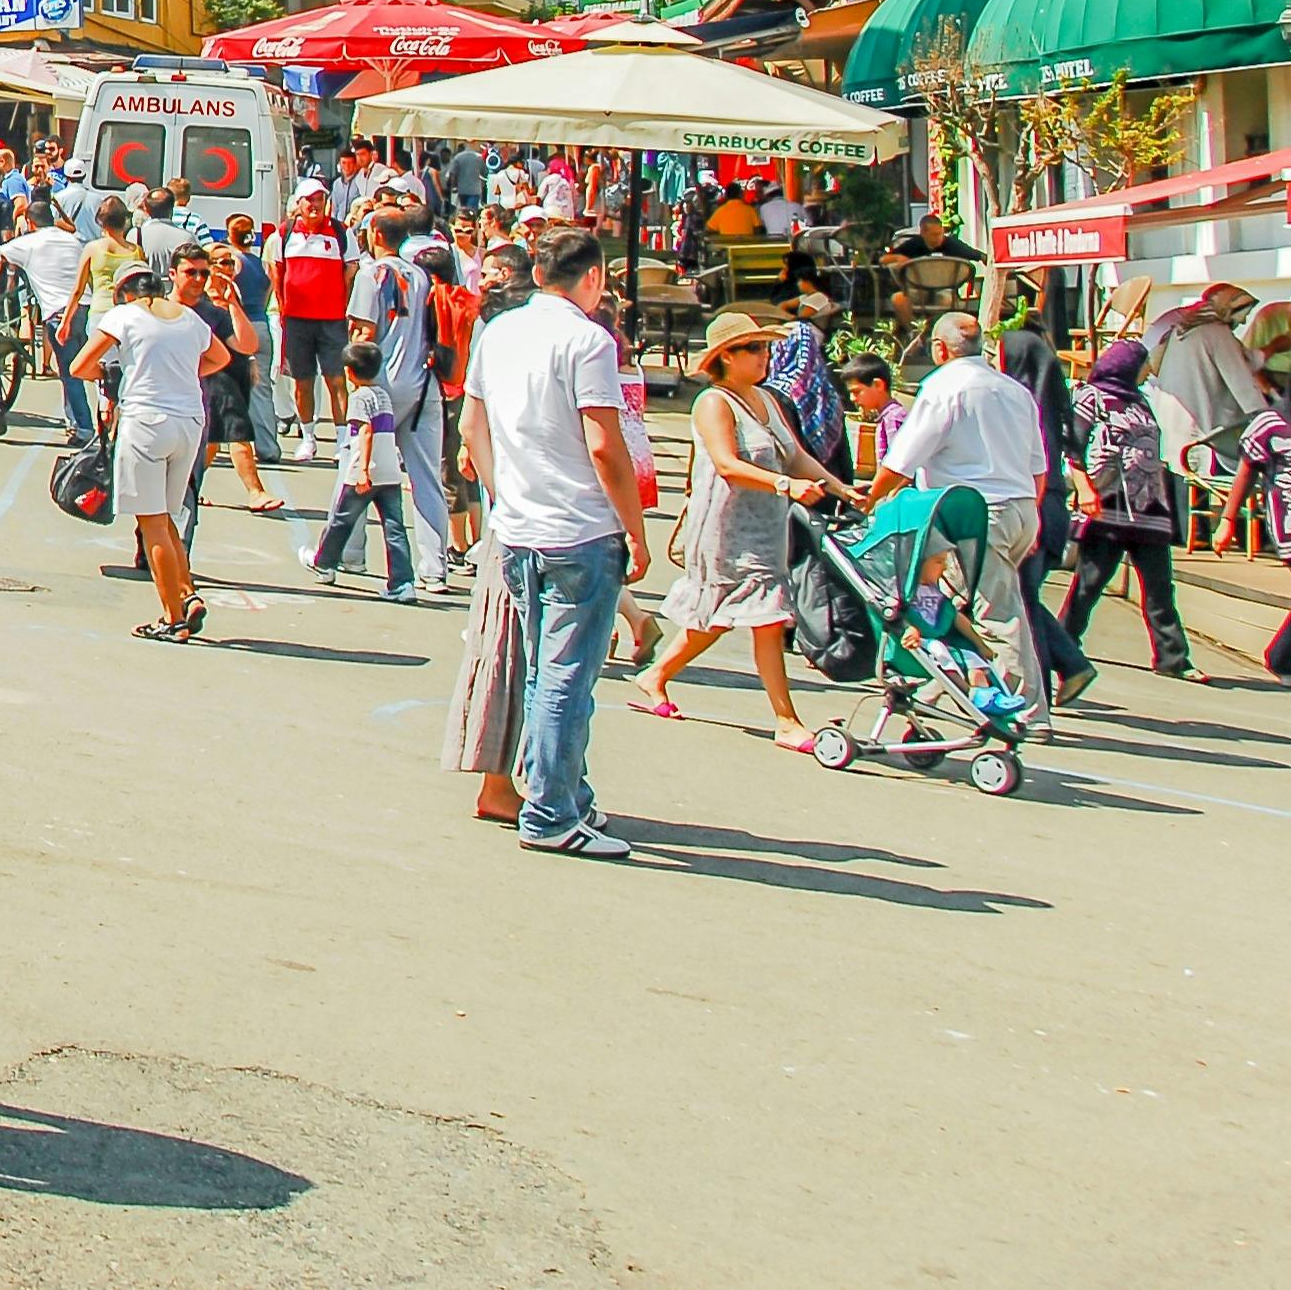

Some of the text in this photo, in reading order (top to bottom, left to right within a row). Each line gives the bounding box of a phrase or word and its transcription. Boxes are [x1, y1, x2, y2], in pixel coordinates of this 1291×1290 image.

[112, 95, 236, 117] AMBULANS
[683, 132, 866, 158] STARBUCKS COFFEE
